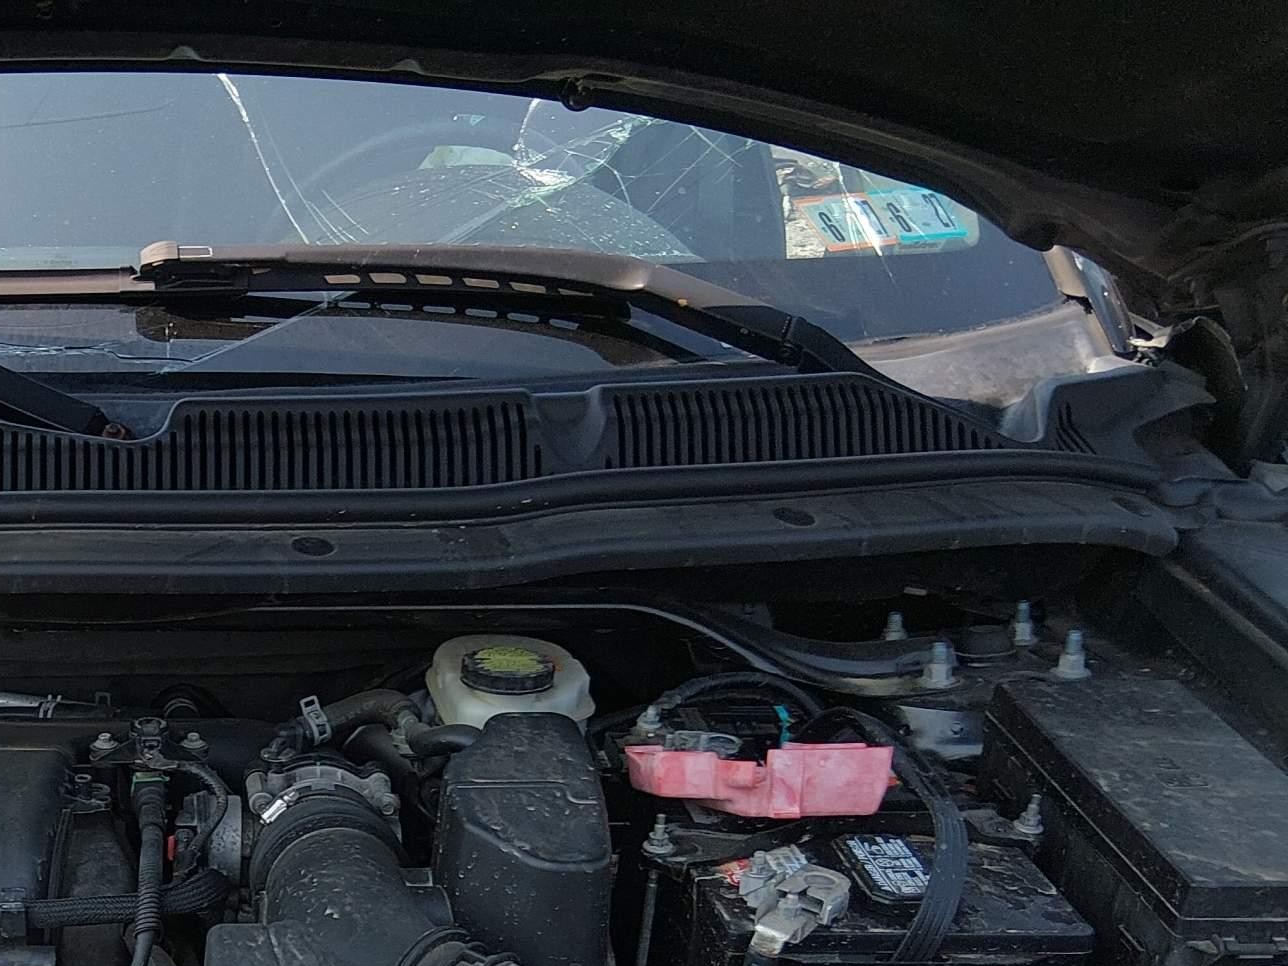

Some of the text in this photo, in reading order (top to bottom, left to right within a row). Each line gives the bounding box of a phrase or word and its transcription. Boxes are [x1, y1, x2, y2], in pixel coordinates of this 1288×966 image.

[818, 211, 846, 242] 6
[886, 192, 957, 233] 6 27
